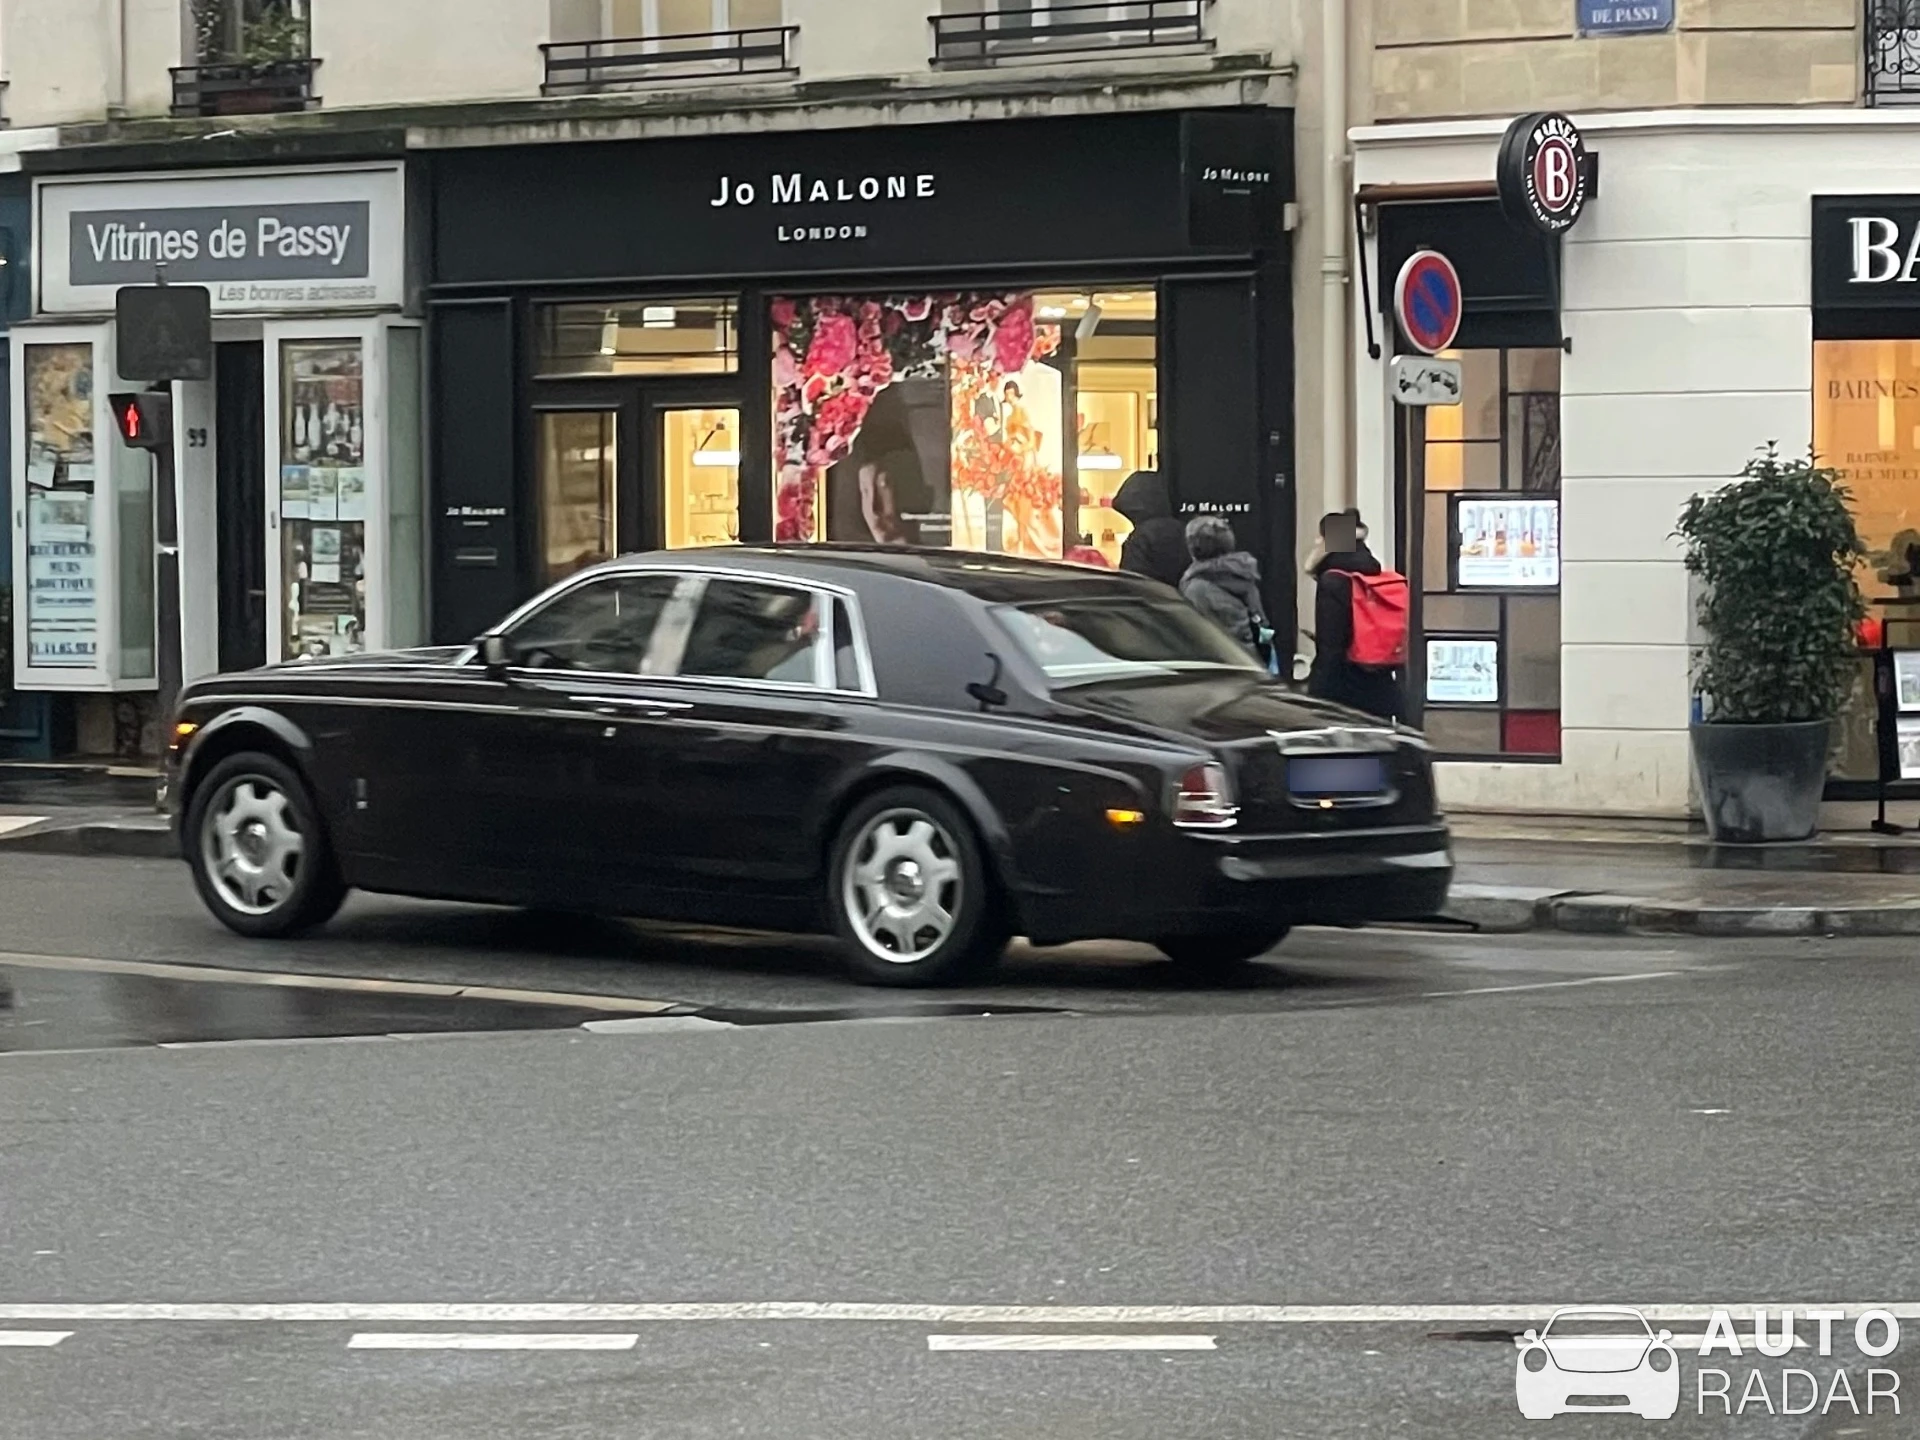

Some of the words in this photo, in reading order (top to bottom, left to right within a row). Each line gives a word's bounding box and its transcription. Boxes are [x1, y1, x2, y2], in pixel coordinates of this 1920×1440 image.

[1592, 9, 1612, 23] DE
[1615, 7, 1658, 22] PASSY
[1545, 147, 1569, 202] B
[710, 176, 755, 206] JO
[771, 173, 935, 203] MALONE
[87, 222, 199, 261] Vitrines
[208, 219, 247, 258] de
[257, 217, 350, 265] Passy
[777, 225, 868, 241] LONDON
[218, 284, 245, 301] Les
[1828, 380, 1919, 400] BARNES
